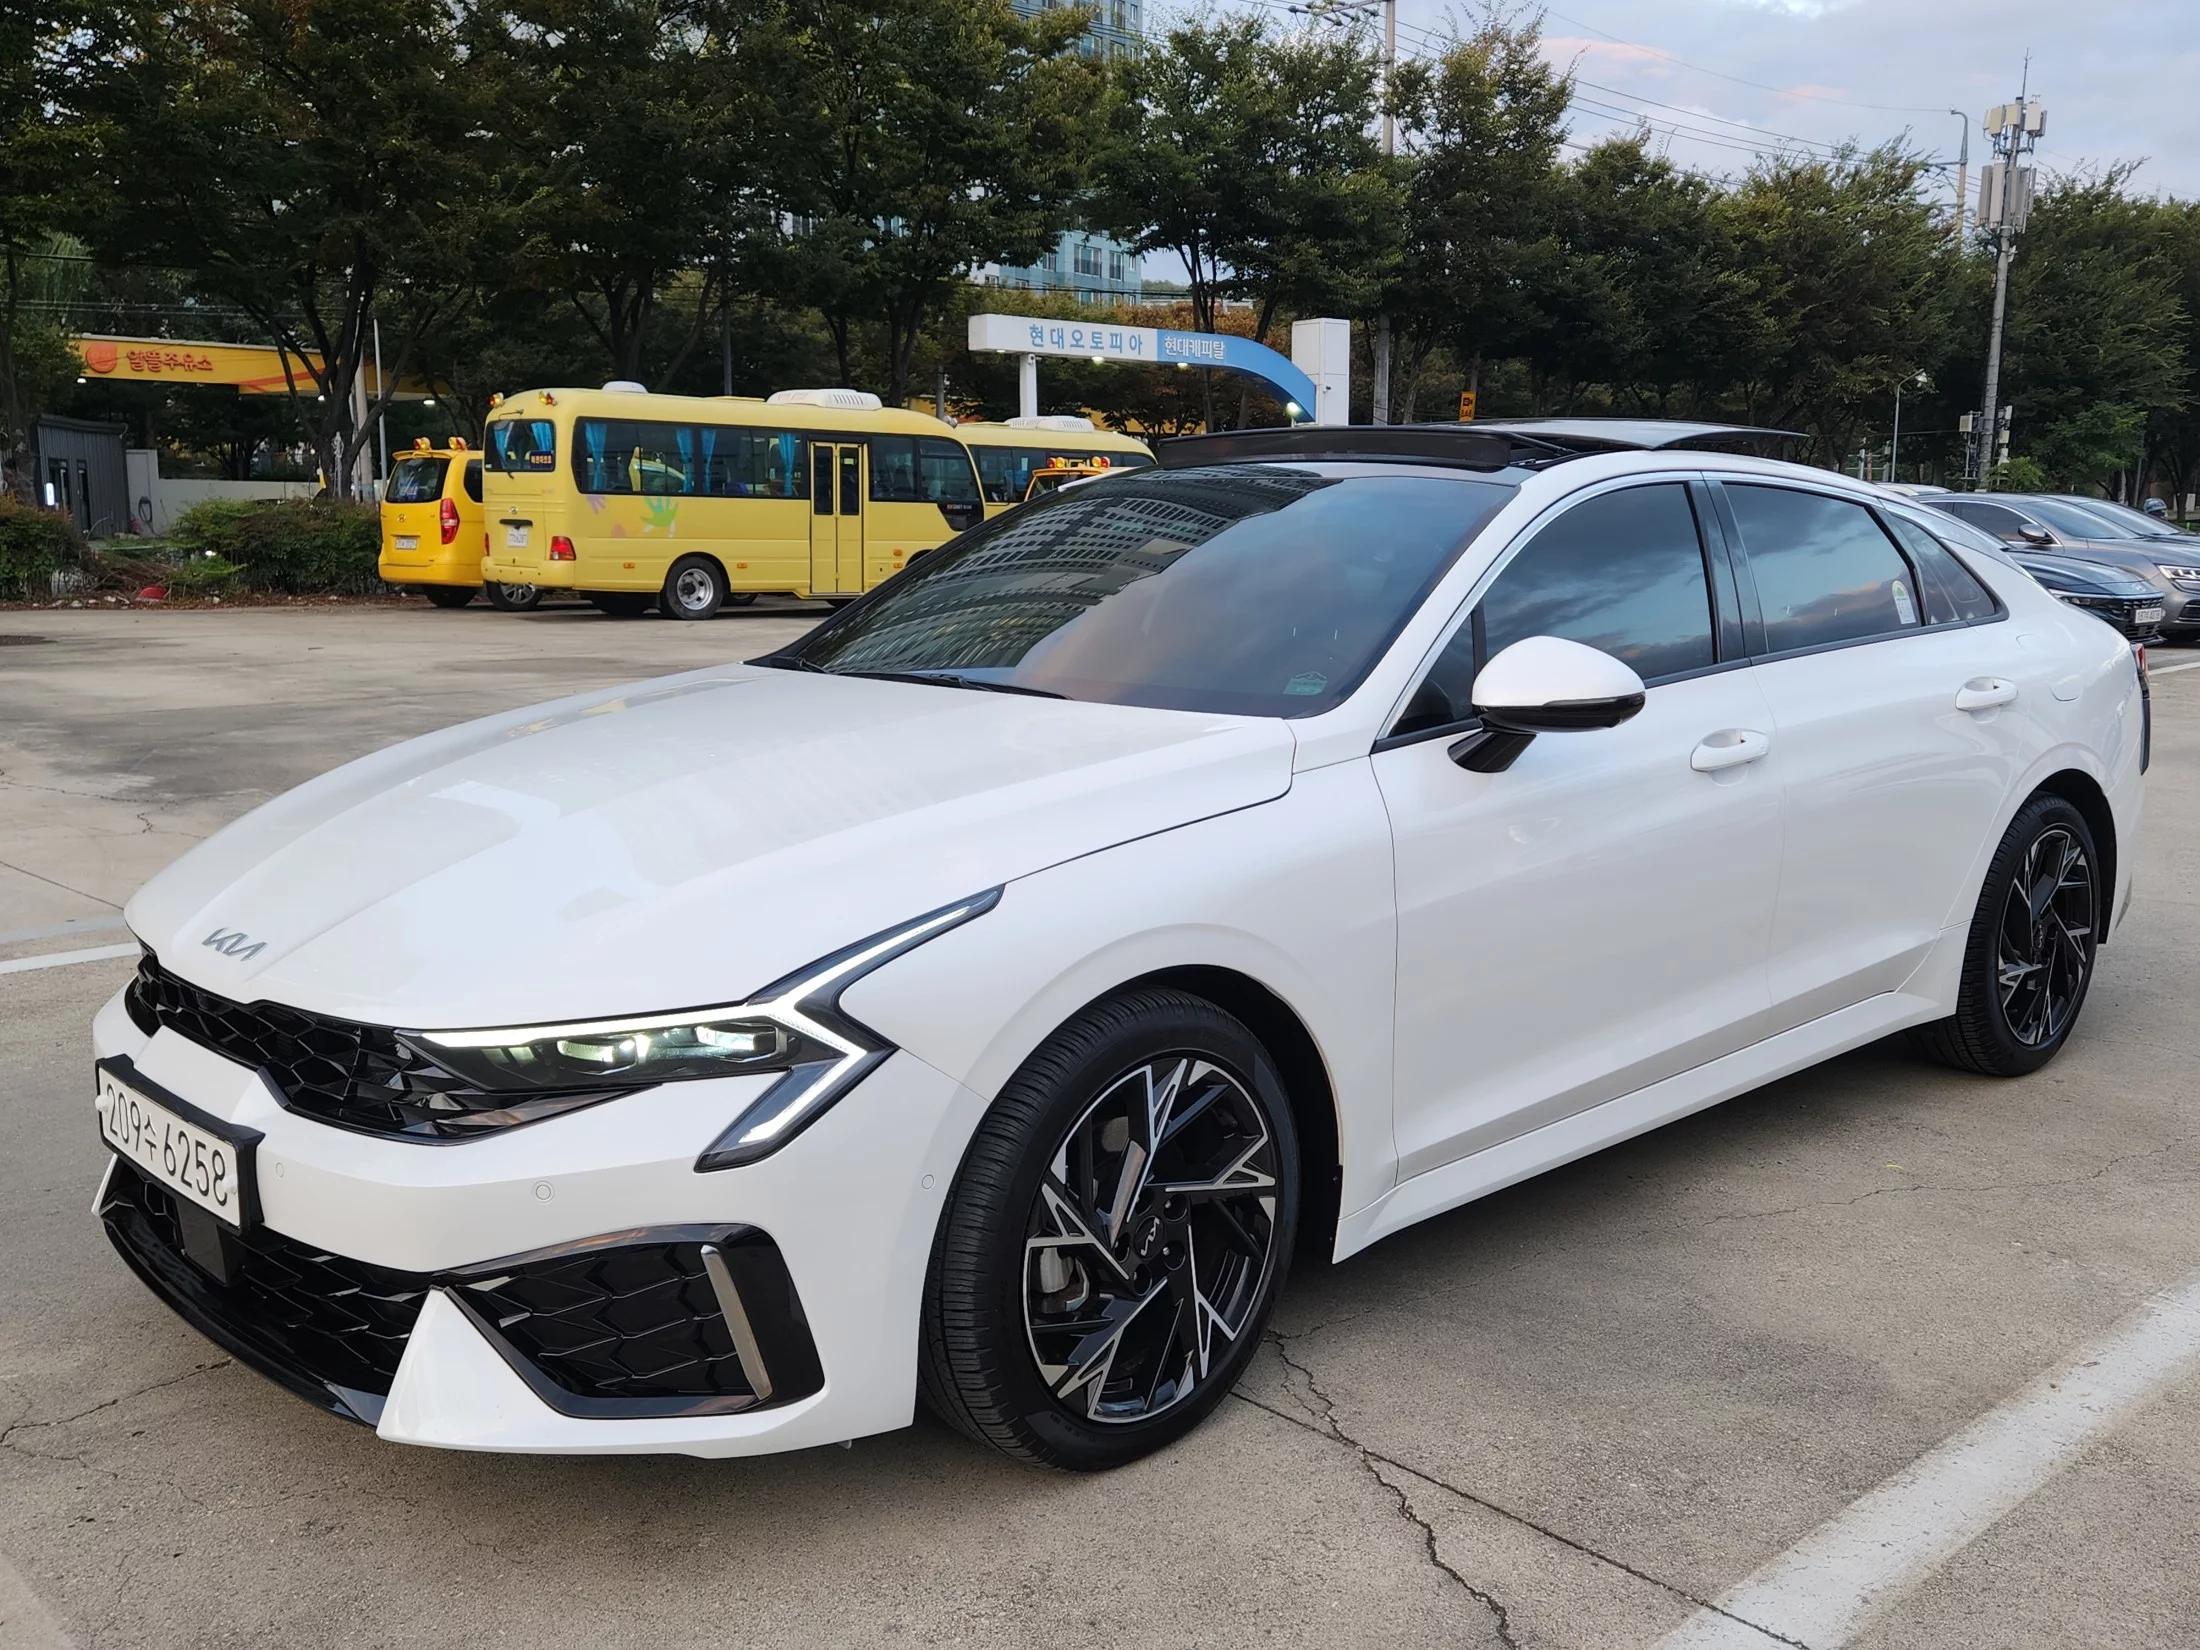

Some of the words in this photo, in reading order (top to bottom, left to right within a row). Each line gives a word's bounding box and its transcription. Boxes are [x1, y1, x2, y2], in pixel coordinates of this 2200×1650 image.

[1029, 323, 1143, 356] 현대오토피아
[1164, 335, 1226, 360] 현대캐피탈
[126, 349, 214, 373] 알뜰주유소
